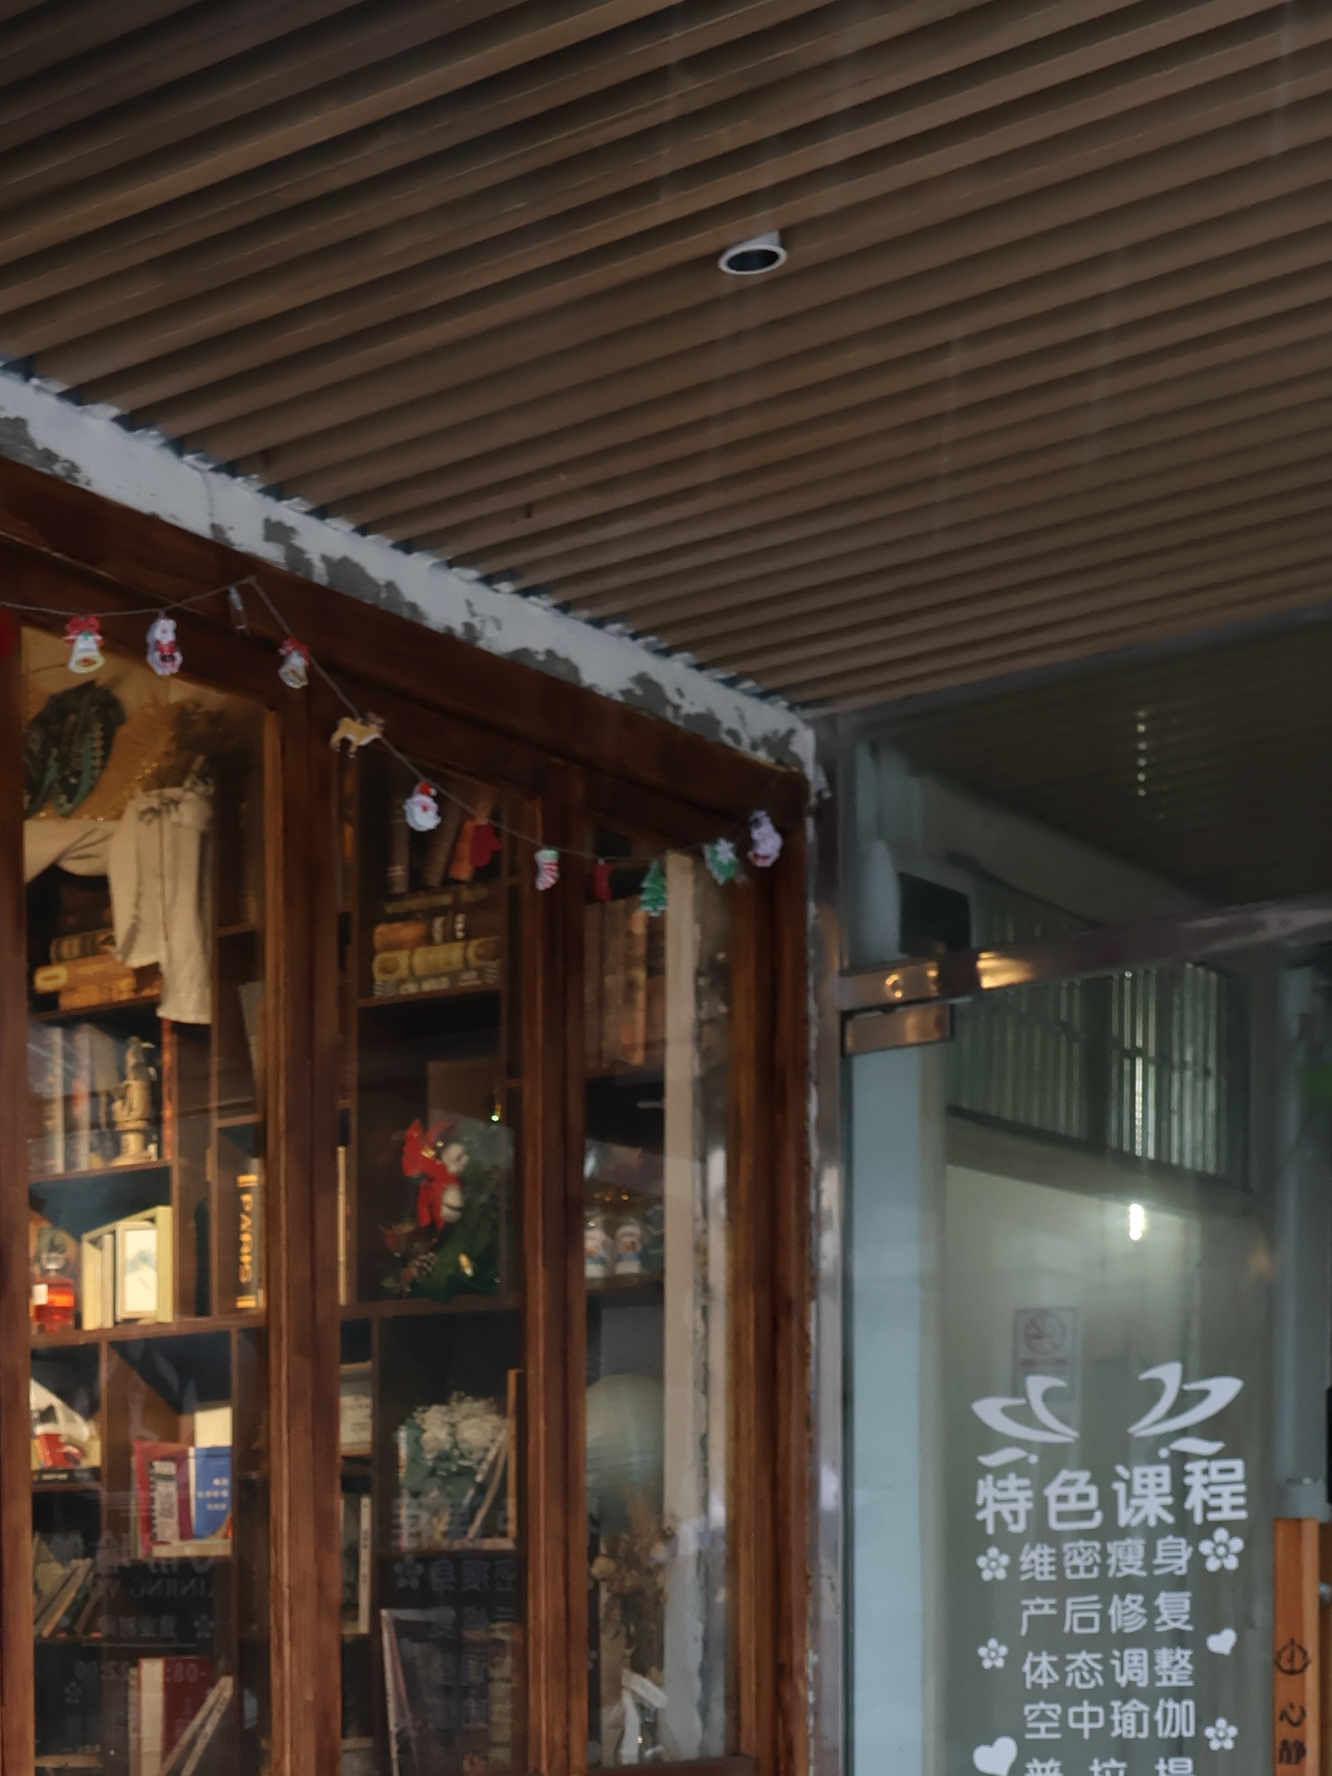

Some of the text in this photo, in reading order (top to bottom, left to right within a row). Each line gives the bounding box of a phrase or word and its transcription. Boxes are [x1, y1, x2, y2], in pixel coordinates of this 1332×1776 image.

[239, 1193, 253, 1284] PARIS
[974, 1458, 1248, 1535] 特色课程
[1019, 1535, 1193, 1582] 维密瘦身
[1020, 1590, 1195, 1636] 产后修复
[1022, 1647, 1195, 1690] 体态调整
[1023, 1698, 1197, 1740] 空中瑜伽
